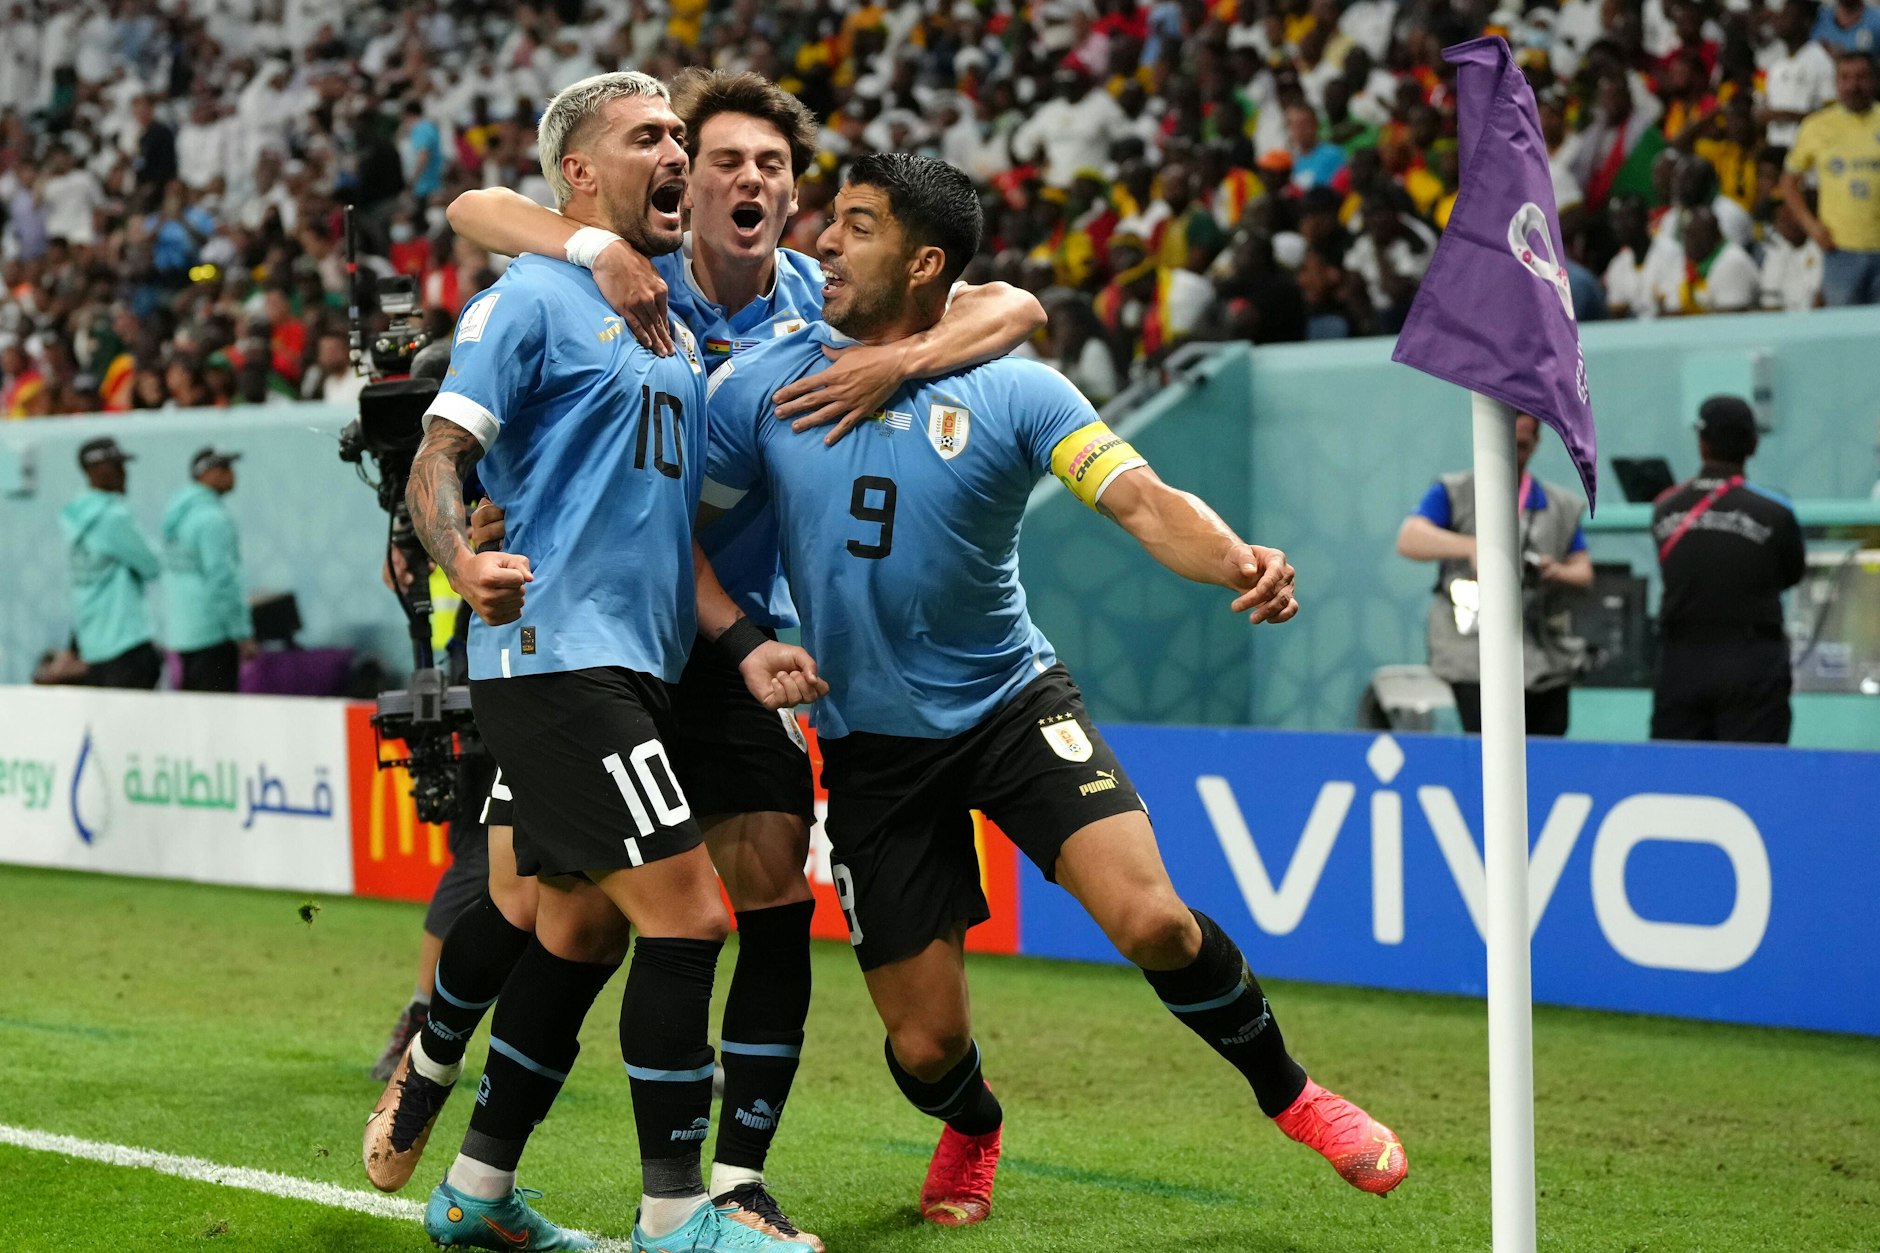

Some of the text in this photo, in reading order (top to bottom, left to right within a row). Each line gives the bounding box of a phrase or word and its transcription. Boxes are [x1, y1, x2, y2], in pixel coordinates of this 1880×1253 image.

[634, 384, 683, 480] 10
[1075, 439, 1125, 482] CHILDRE
[847, 475, 897, 559] 9
[124, 754, 333, 829] قطر للطاقة
[602, 738, 691, 838] 10
[1079, 778, 1116, 797] PUMA
[1196, 732, 1772, 973] vivo
[427, 1011, 455, 1041] UMA
[735, 1107, 772, 1130] PUMA
